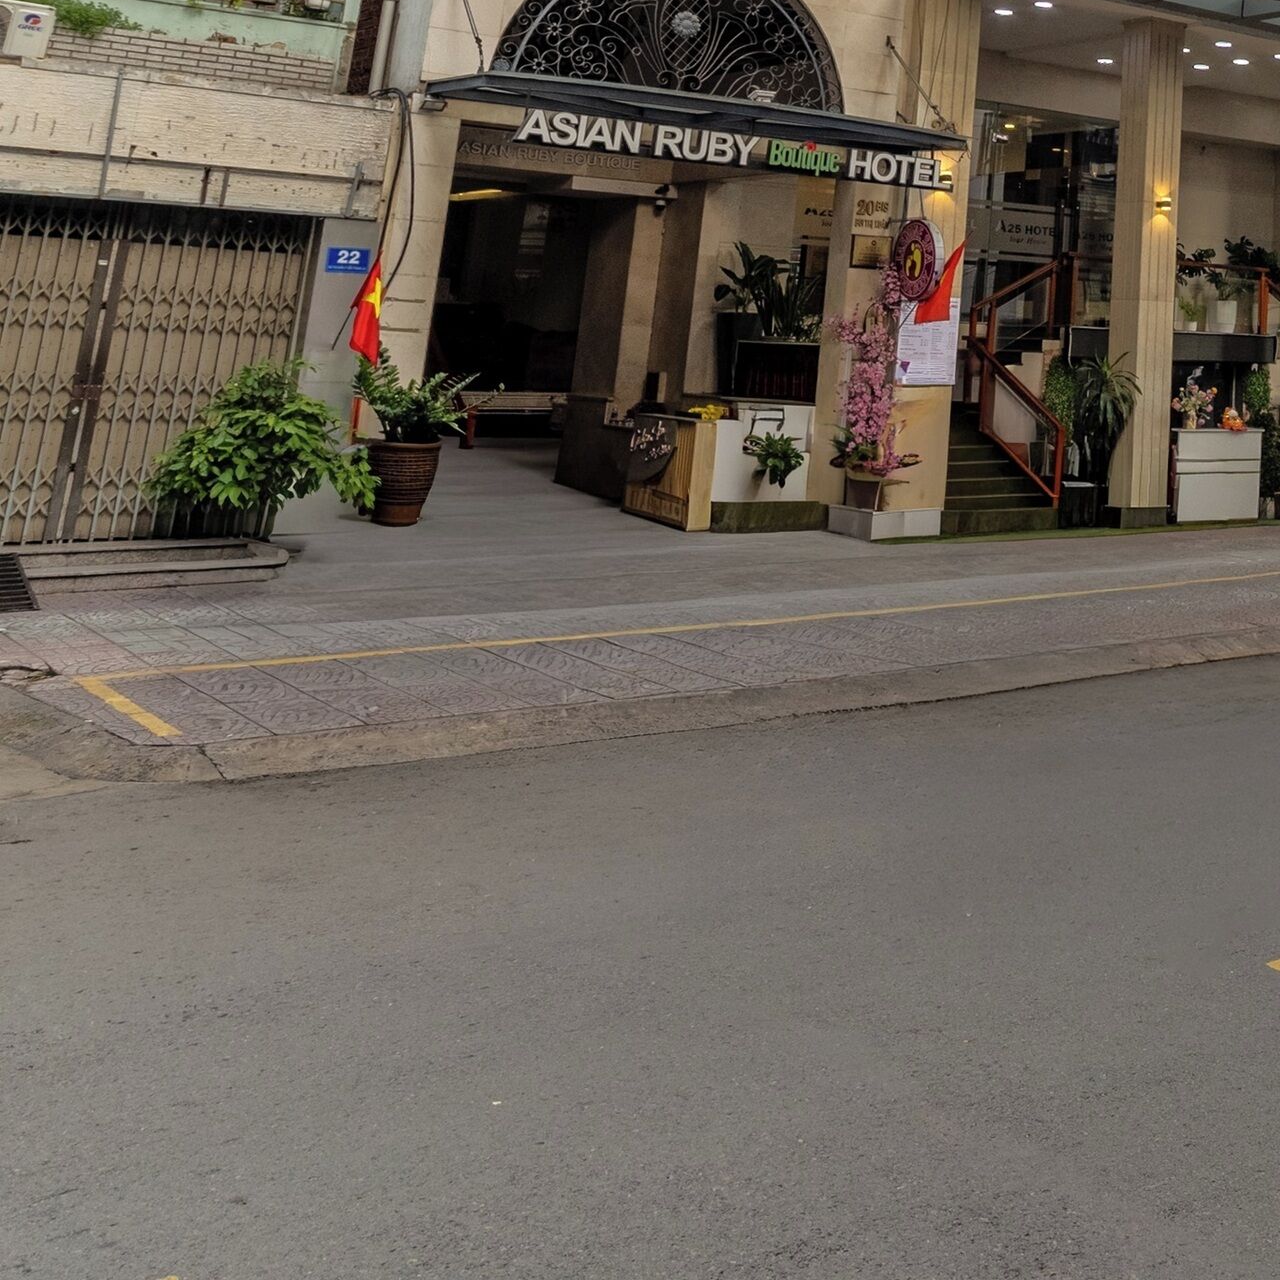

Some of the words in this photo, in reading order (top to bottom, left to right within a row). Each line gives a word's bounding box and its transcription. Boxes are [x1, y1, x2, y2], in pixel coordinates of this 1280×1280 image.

[459, 141, 511, 158] ASIAN
[517, 147, 559, 163] RUBY
[563, 153, 641, 171] BOUTIQUE
[513, 108, 643, 154] ASIAN
[653, 123, 760, 167] RUBY
[769, 140, 842, 177] Boutique
[848, 148, 952, 190] HOTEL
[856, 200, 874, 216] 20
[1025, 225, 1055, 237] HOTE
[337, 250, 360, 264] 22
